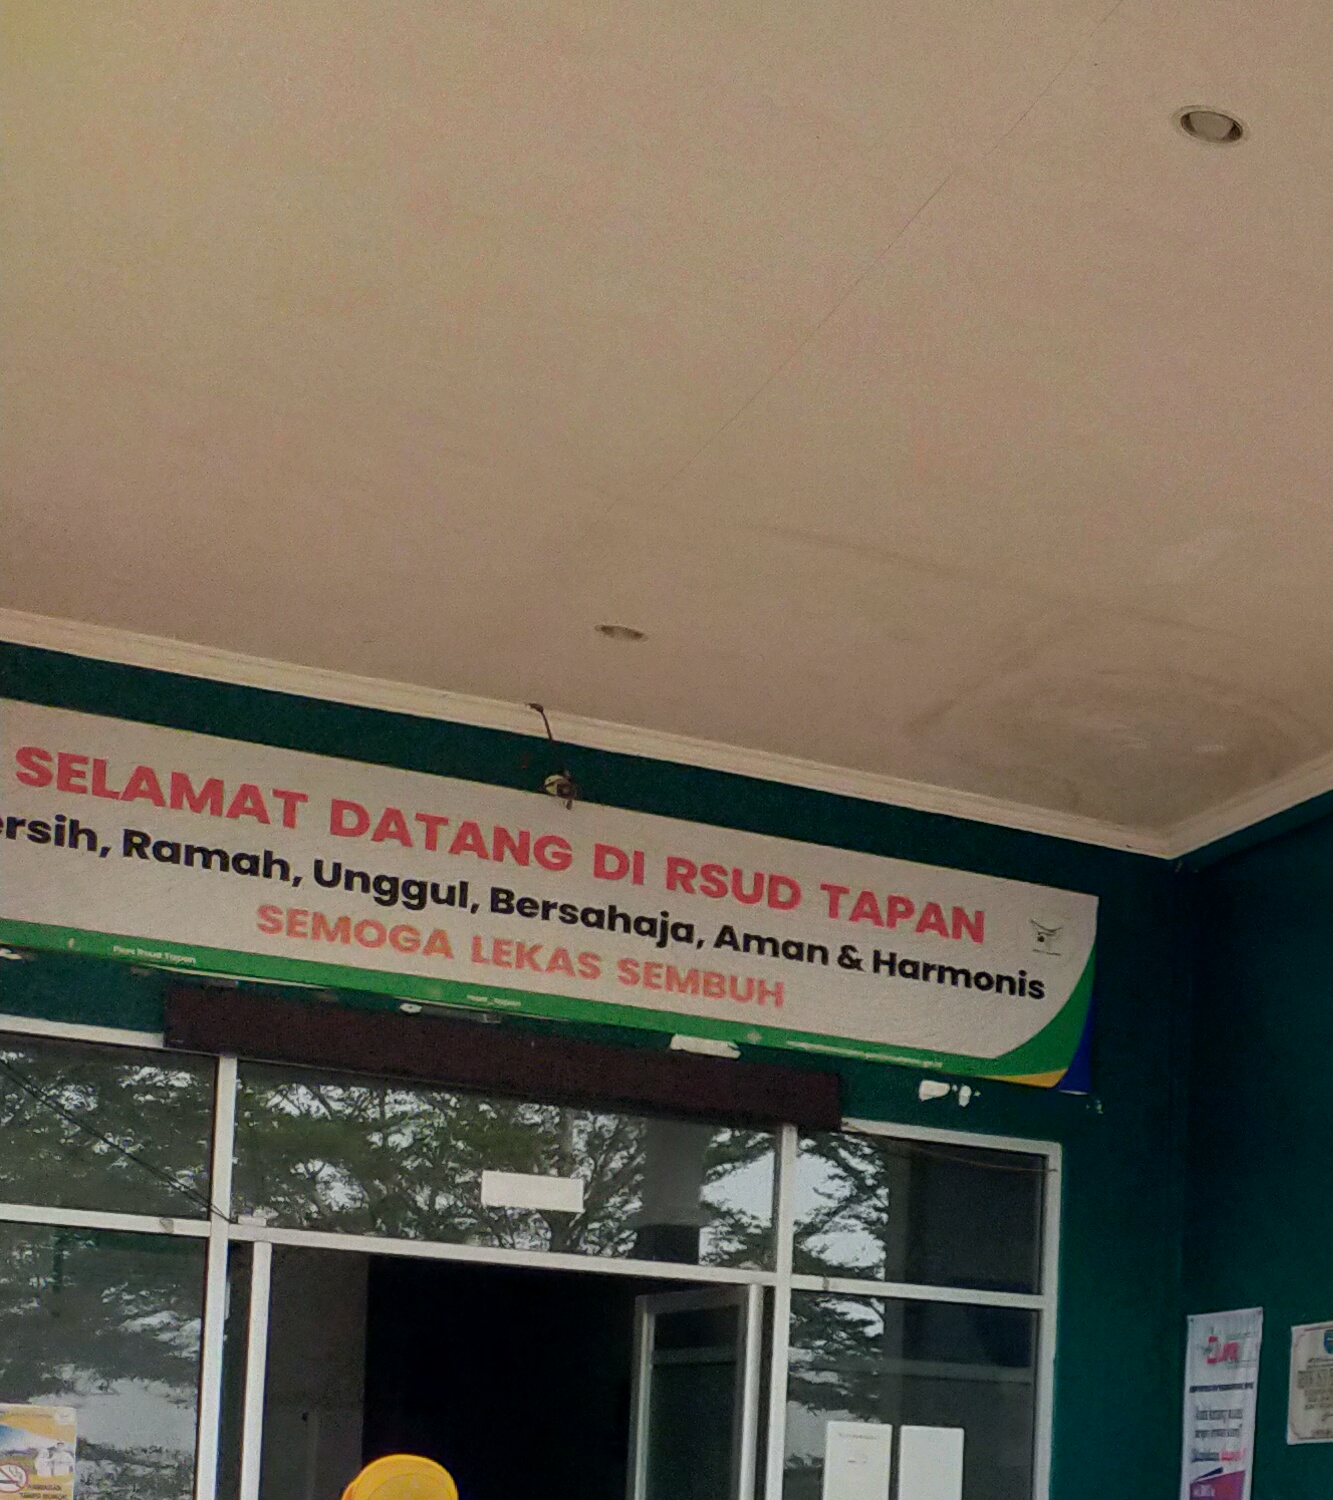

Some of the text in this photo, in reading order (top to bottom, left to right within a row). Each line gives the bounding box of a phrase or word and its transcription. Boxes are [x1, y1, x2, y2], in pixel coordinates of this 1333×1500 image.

[0, 812, 1046, 1000] rsih, Ramah, Unggul, Bersahaja, Aman & Harmonis
[15, 745, 986, 945] SELAMAT DATANG DI RSUD TAPAN
[258, 905, 785, 1008] SEMOGA LEKAS SEMBUH
